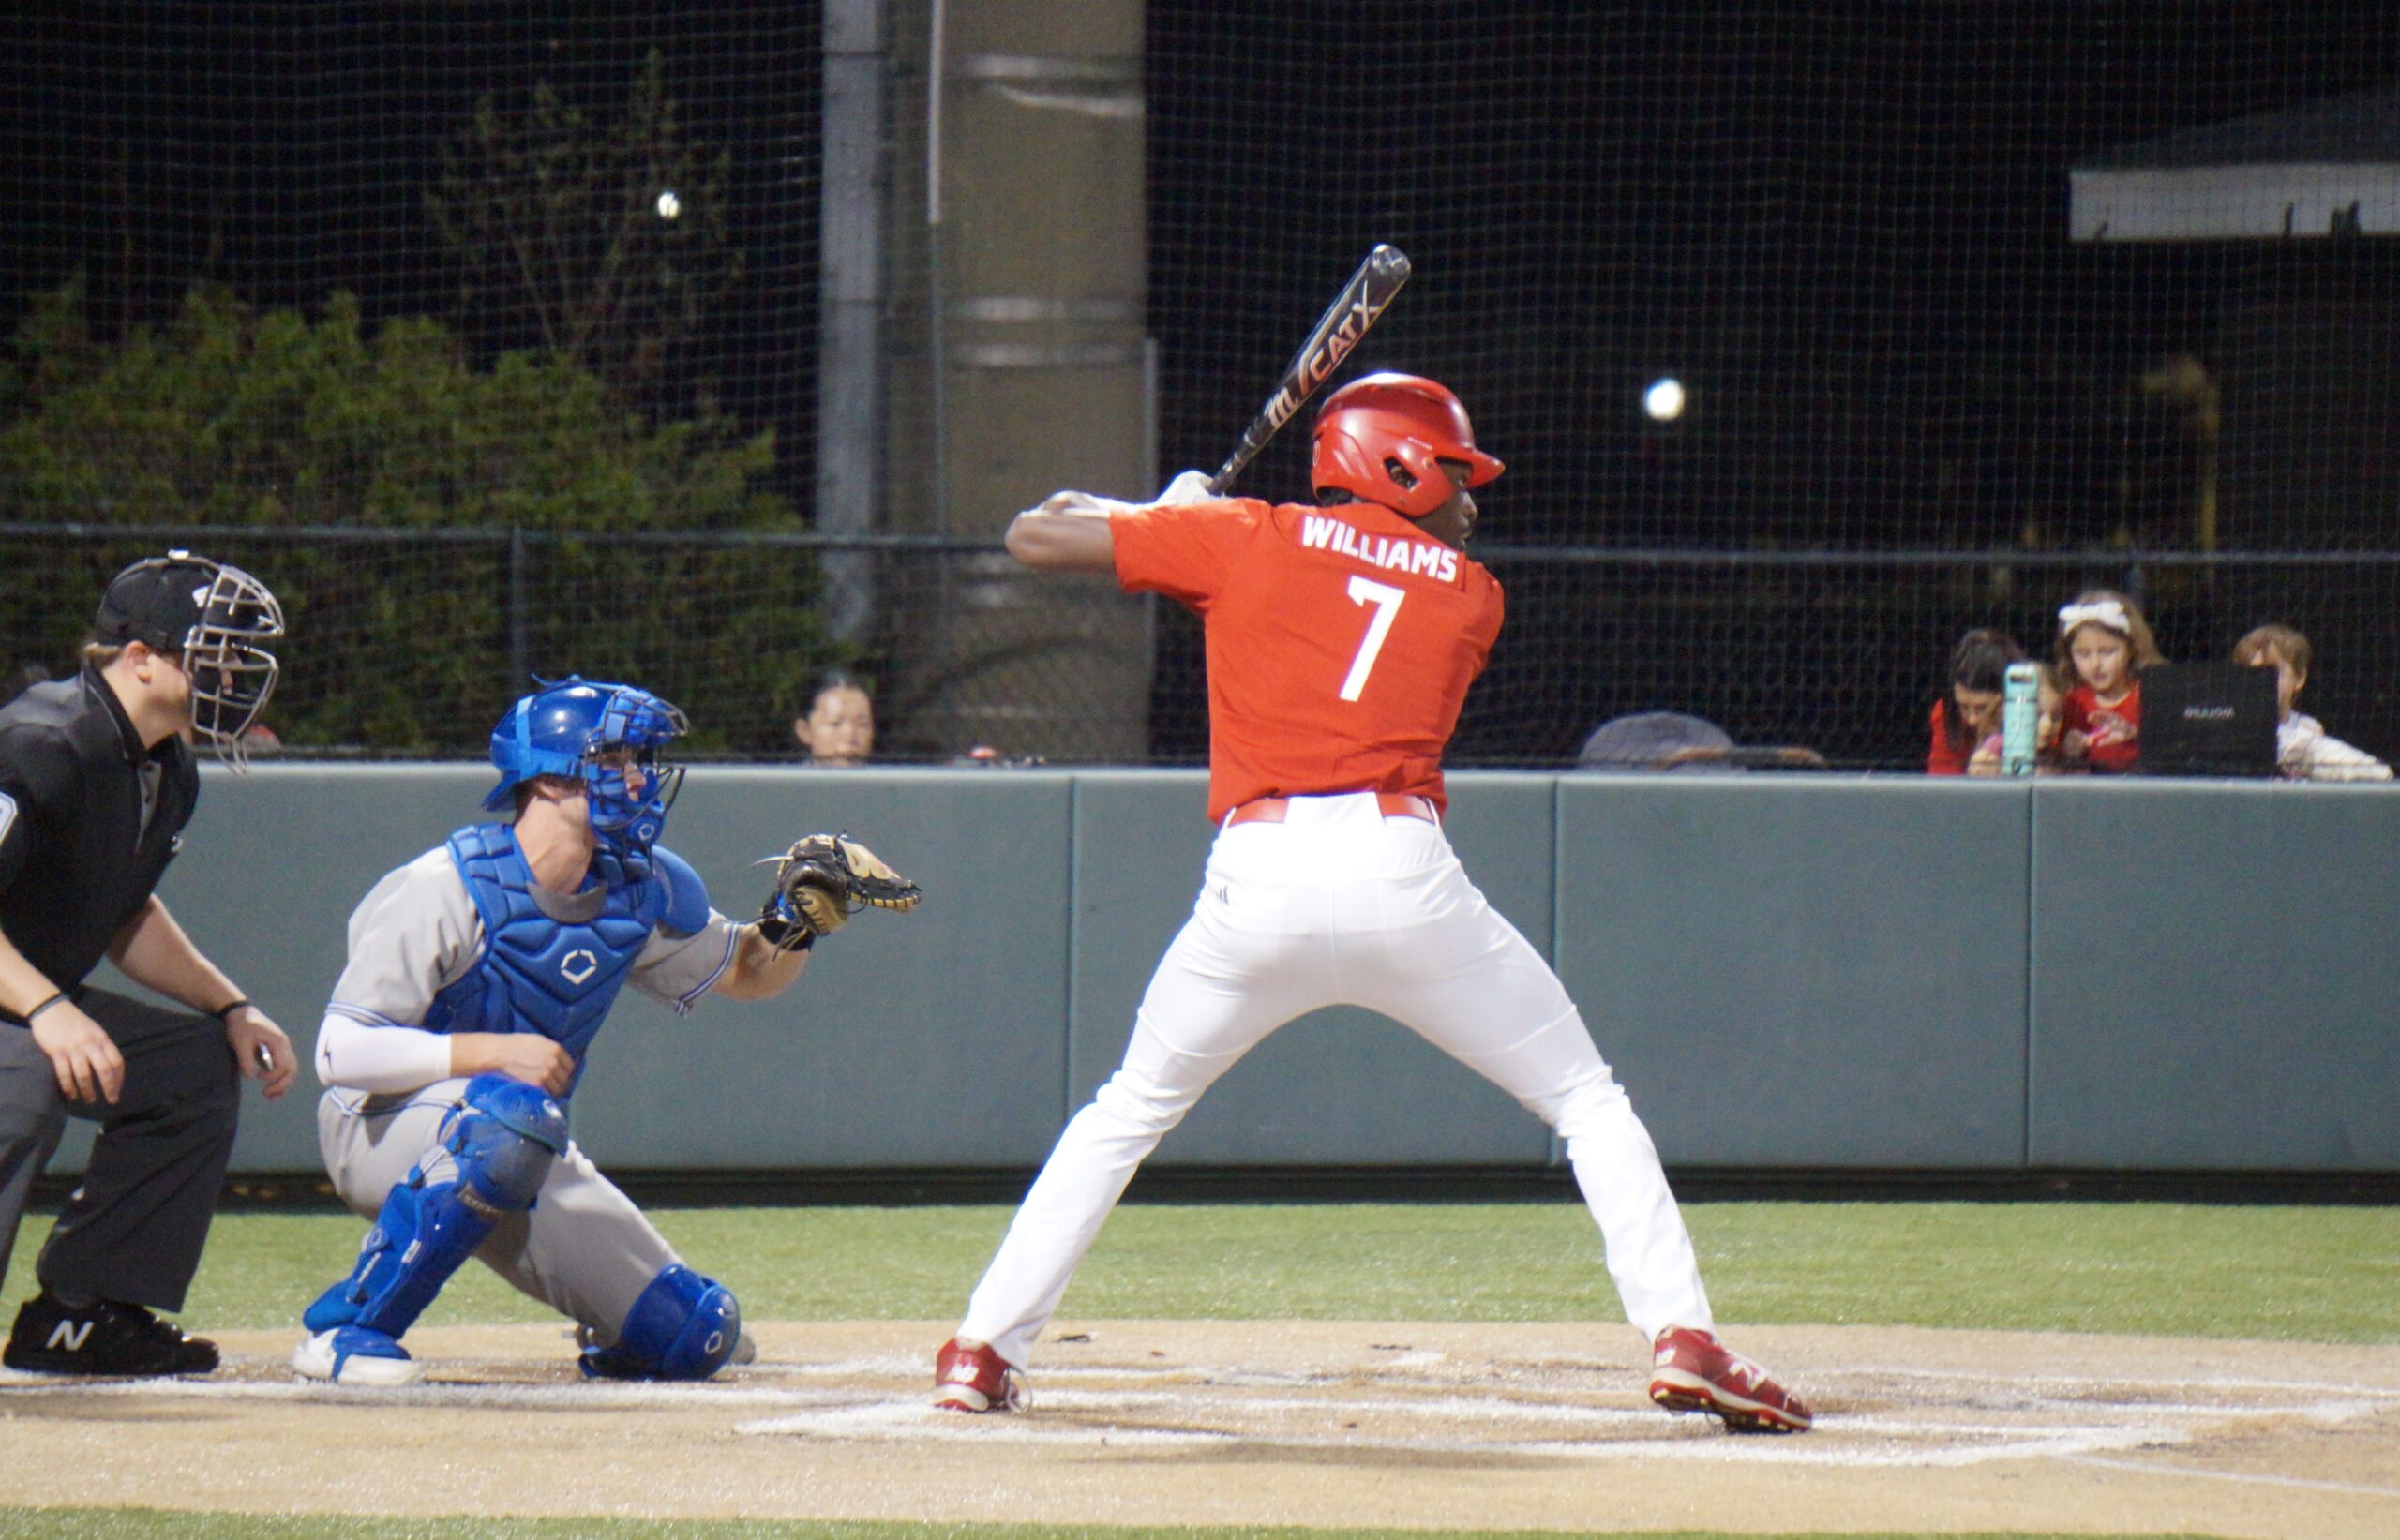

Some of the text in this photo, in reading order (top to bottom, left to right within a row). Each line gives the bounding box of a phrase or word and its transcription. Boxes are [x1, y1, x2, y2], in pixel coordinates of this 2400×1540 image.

[1302, 516, 1458, 583] WILLIAMS
[1339, 575, 1406, 702] 7
[46, 1319, 94, 1351] N
